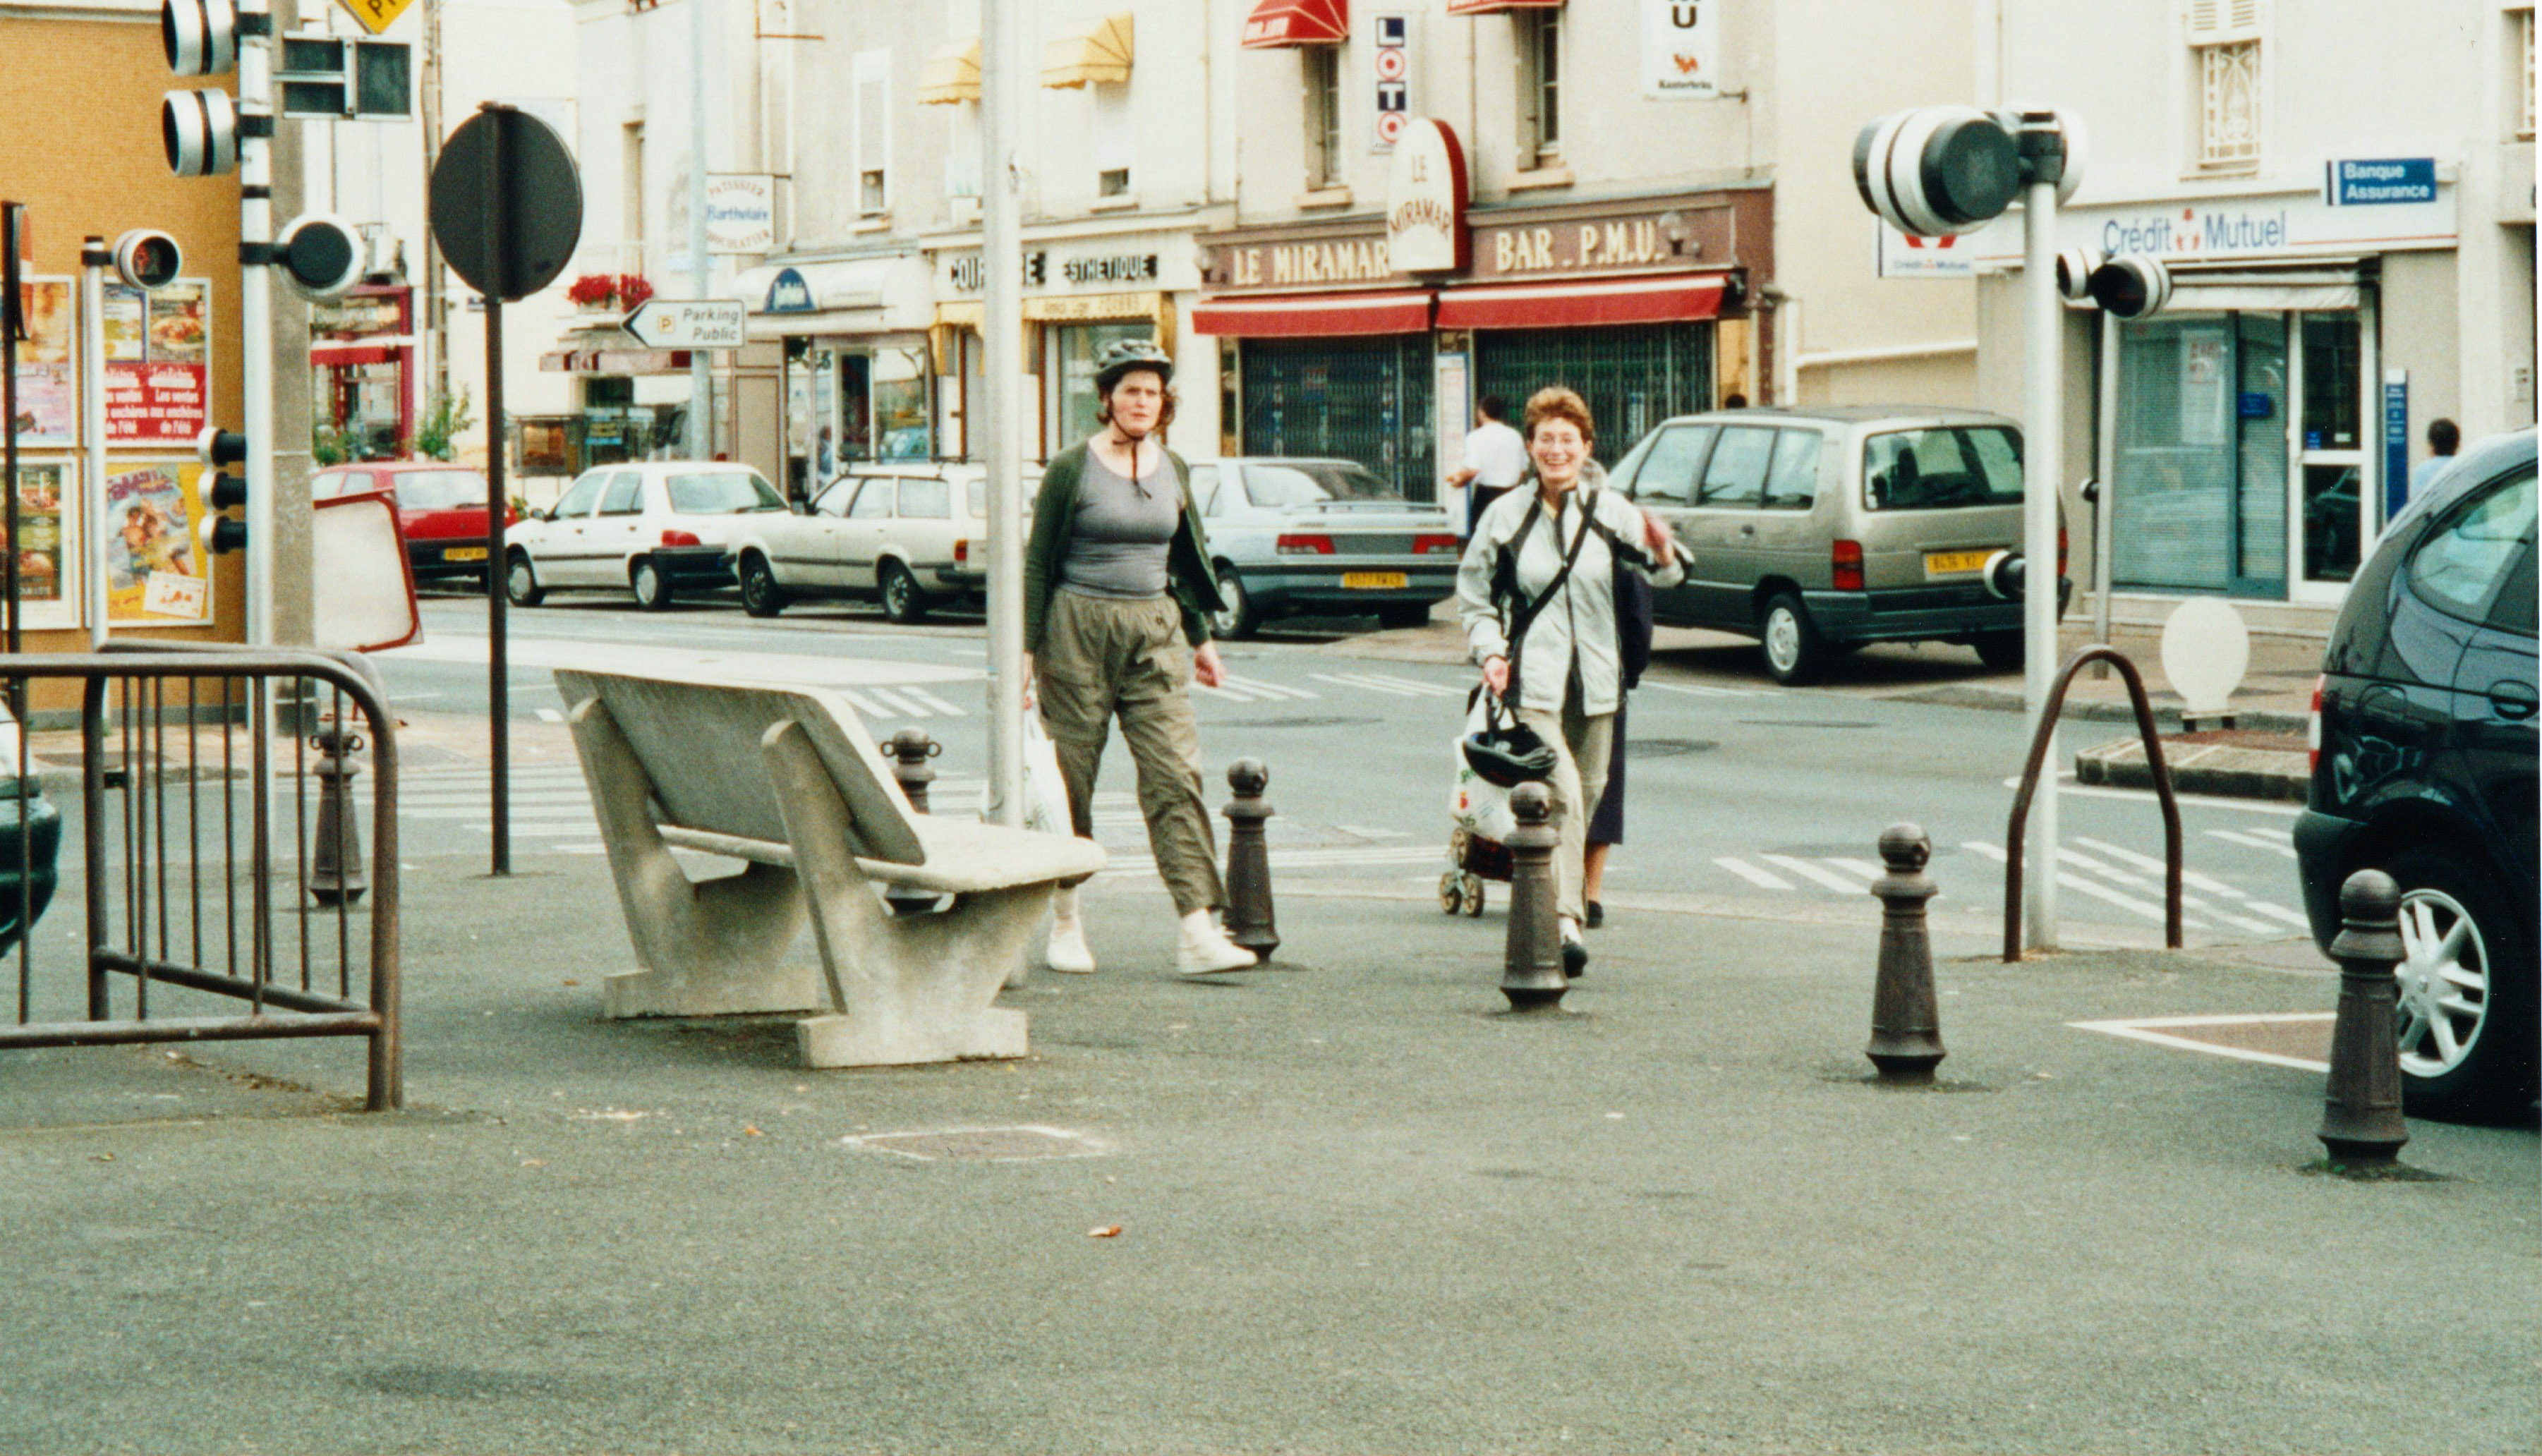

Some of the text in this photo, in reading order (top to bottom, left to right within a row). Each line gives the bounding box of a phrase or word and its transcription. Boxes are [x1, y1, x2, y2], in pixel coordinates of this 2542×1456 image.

[1412, 154, 1428, 183] LE
[2344, 163, 2405, 181] Banque
[2347, 183, 2430, 199] Assurance
[1388, 198, 1452, 234] MIRAMAR
[2103, 210, 2286, 254] Crédit Mutuel
[1235, 240, 1391, 284] LE MIRAMAR
[1496, 227, 1554, 271] BAR
[1064, 254, 1156, 283] ESTHETIQUE
[682, 308, 739, 324] Parking
[693, 327, 737, 340] Public
